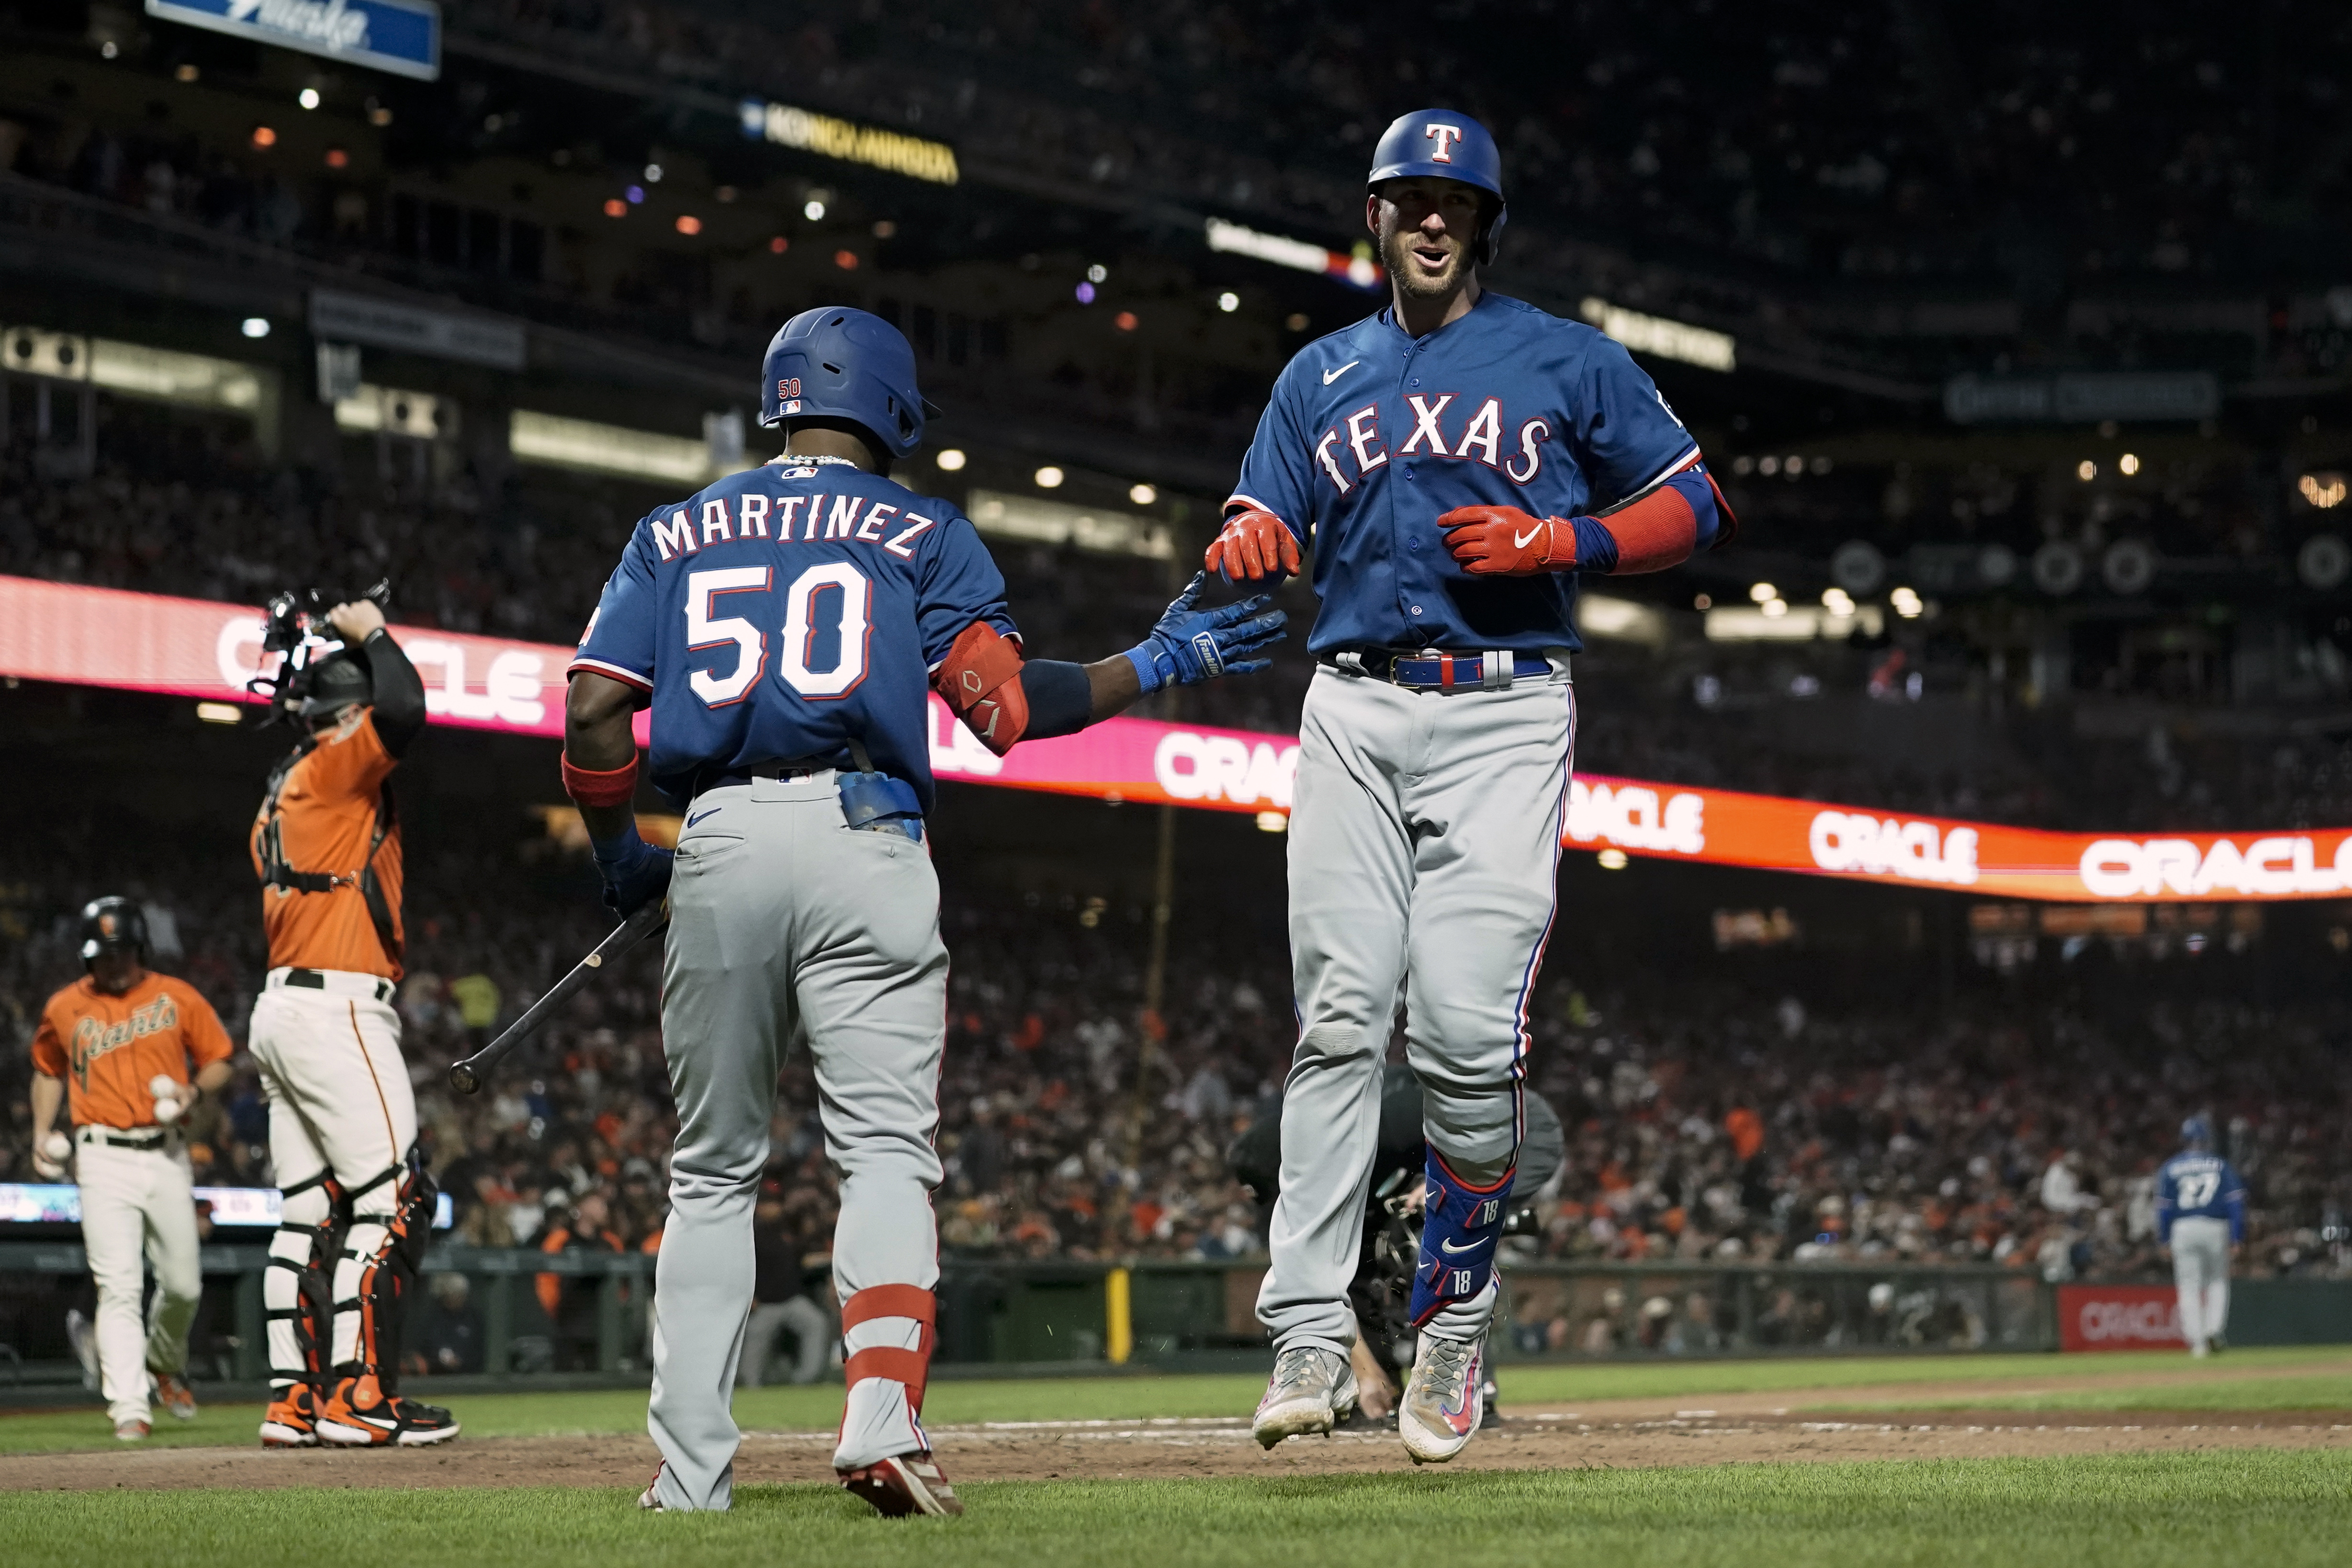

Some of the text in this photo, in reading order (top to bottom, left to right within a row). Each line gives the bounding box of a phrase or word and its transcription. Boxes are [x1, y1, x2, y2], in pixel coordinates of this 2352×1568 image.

[1426, 123, 1462, 164] T
[778, 378, 801, 399] 50
[1315, 393, 1551, 499] TEXAS
[650, 493, 936, 564] MARTINEZ
[682, 561, 875, 711] 50
[1195, 638, 1219, 674] Franklin
[1811, 811, 1979, 884] ORACLE
[72, 992, 178, 1094] Giants
[1483, 1199, 1499, 1224] 18
[1453, 1270, 1471, 1295] 18
